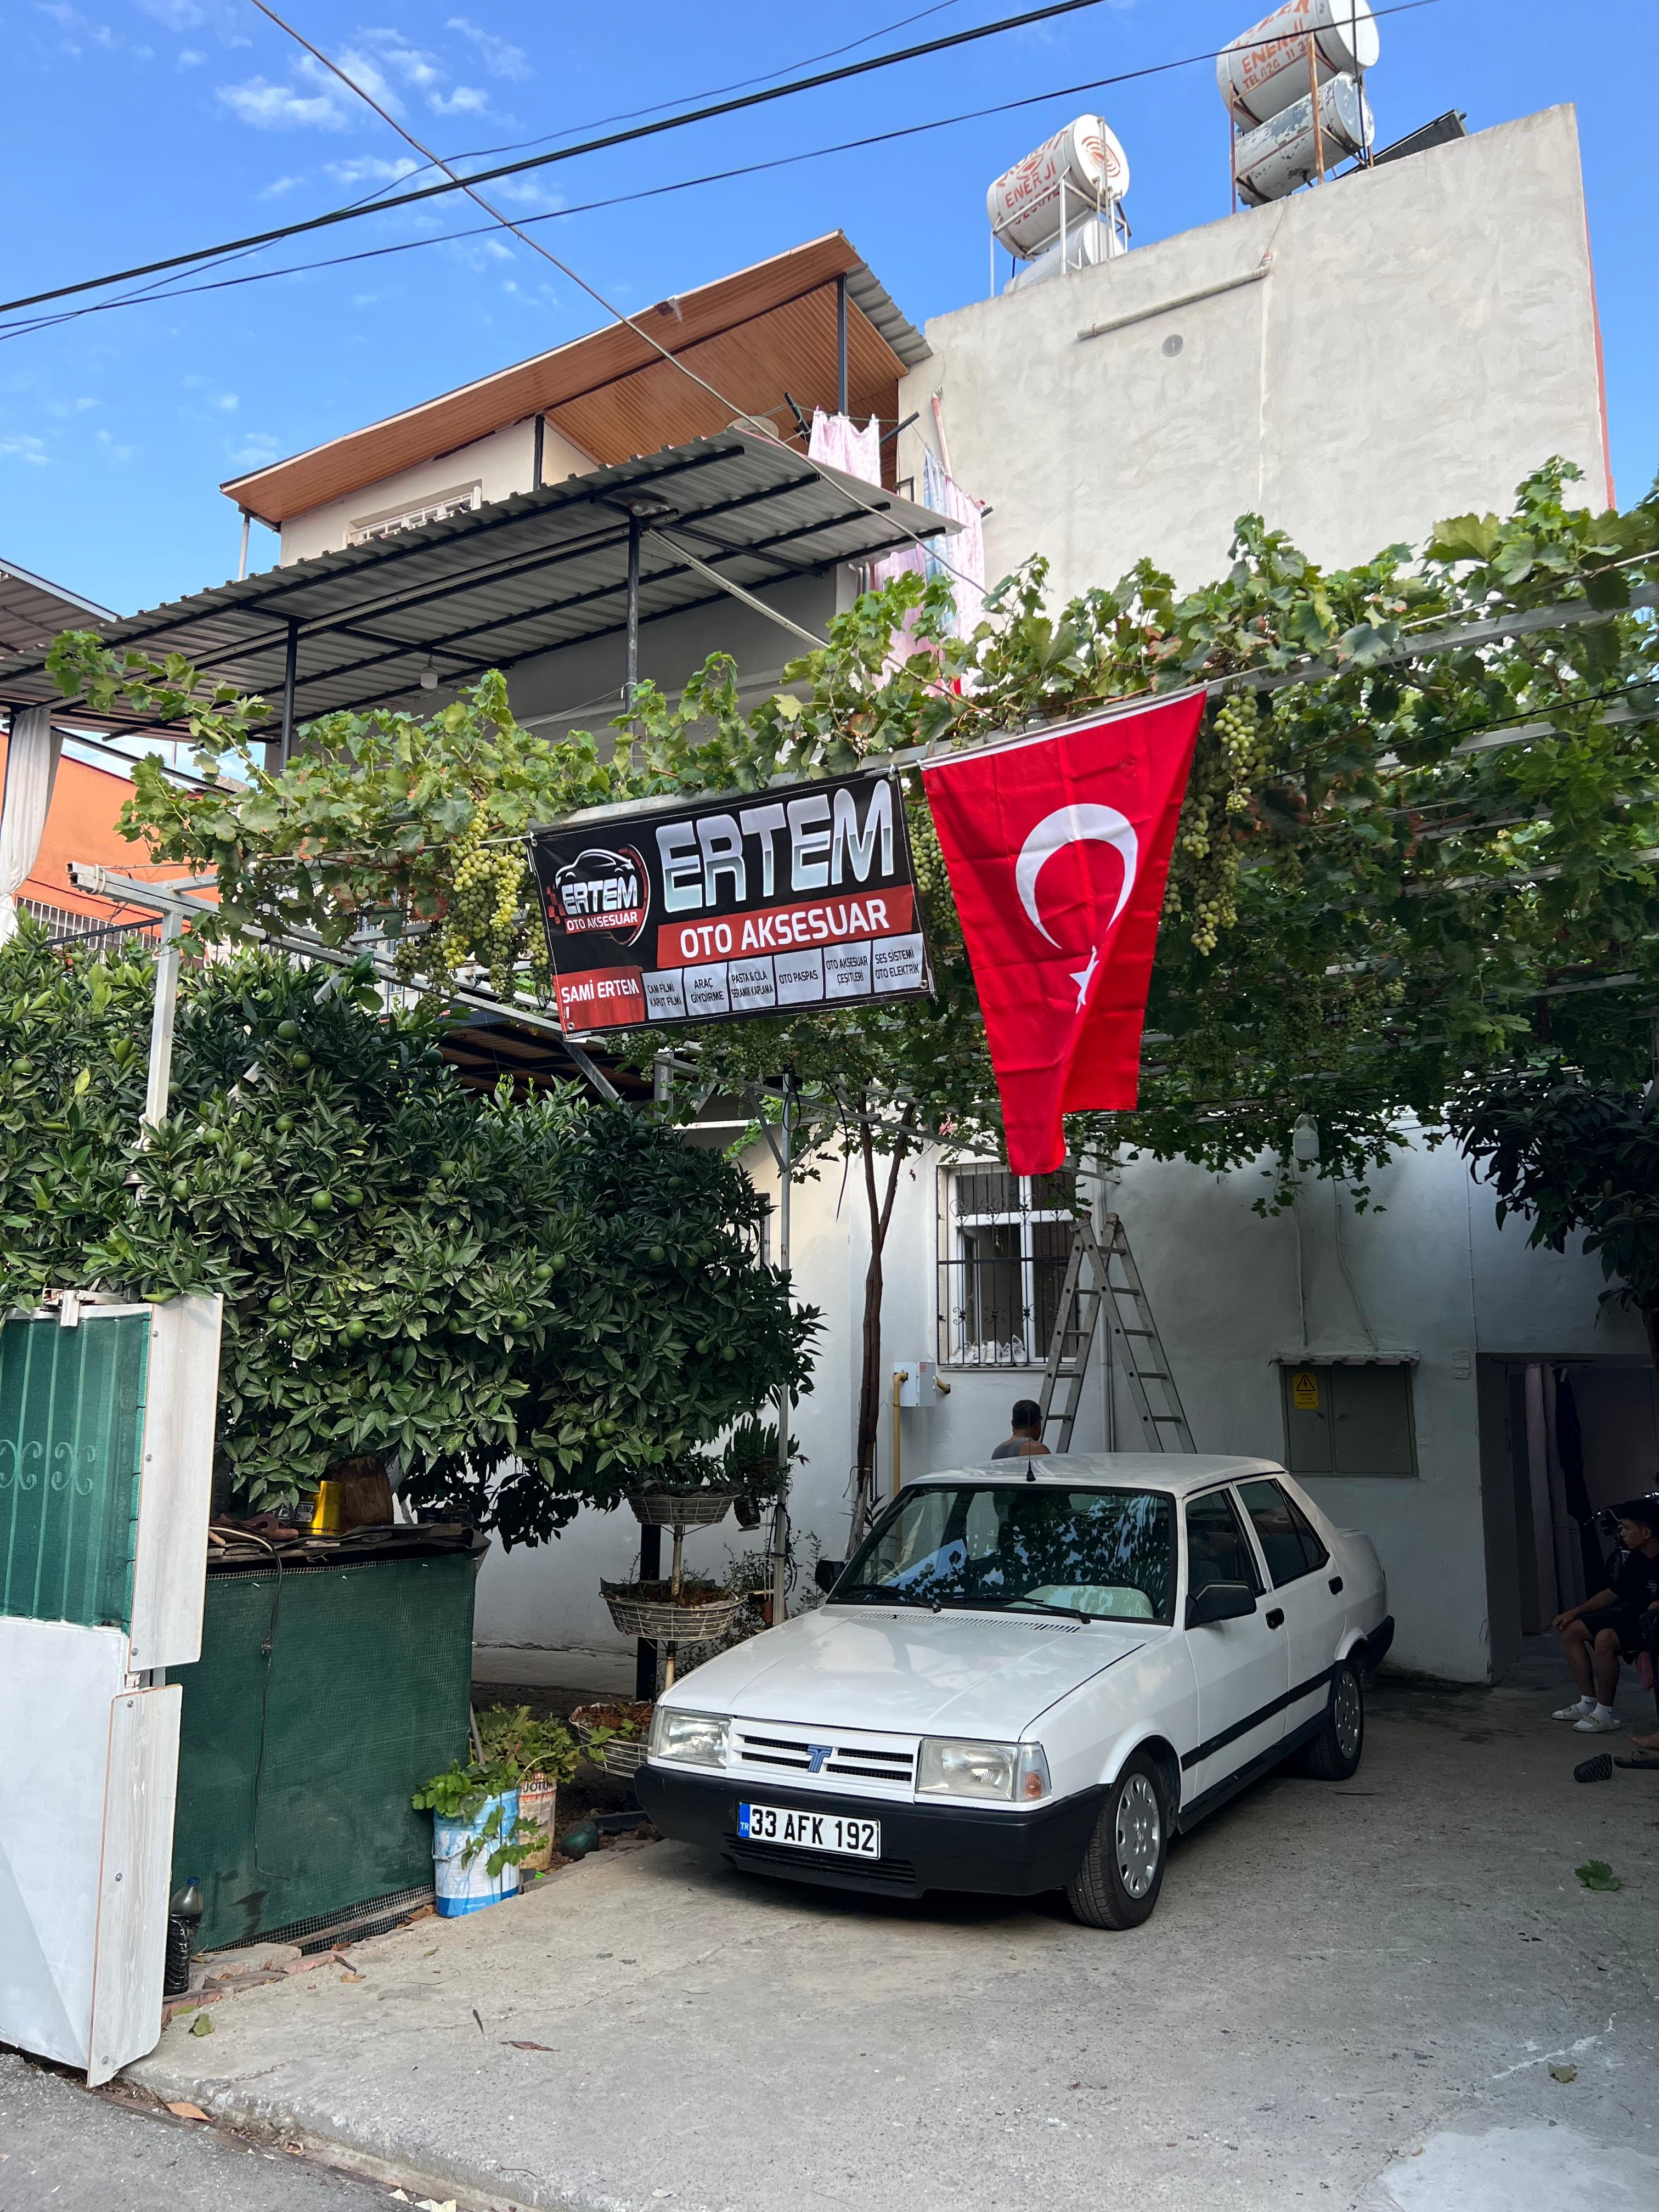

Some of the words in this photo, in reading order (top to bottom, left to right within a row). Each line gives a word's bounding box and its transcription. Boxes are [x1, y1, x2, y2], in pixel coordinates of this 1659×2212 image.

[656, 779, 894, 913] ERTEM
[561, 874, 637, 915] ERTEM
[566, 918, 585, 931] OTO
[588, 911, 638, 929] AKSESUAR
[680, 923, 732, 958] OTO
[741, 899, 889, 951] AKSESUAR
[826, 961, 838, 970] OTO
[839, 956, 868, 968] AKSESUAR
[875, 953, 888, 964] SES
[888, 946, 915, 962] SİSTEMİ
[731, 973, 749, 984] PASTA
[749, 972, 755, 981] &
[754, 969, 768, 981] CİLA
[779, 973, 793, 984] OTO
[793, 970, 819, 982] PASPAS
[837, 969, 865, 986] ÇEŞİTLERİ
[874, 969, 888, 979] OTO
[890, 961, 919, 977] ELEKTRİK
[561, 979, 595, 1003] SAMİ
[597, 978, 640, 998] ERTEM
[647, 984, 659, 994] CAM
[659, 981, 675, 993] FİLMİ
[694, 978, 714, 990] ARAÇ
[751, 984, 774, 996] KAPLAMA
[649, 997, 666, 1007] KAPUT
[667, 994, 682, 1006] FİLMİ
[691, 990, 724, 1003] GİYDİRME
[740, 1822, 749, 1831] TR
[752, 1808, 777, 1837] 33
[784, 1814, 823, 1845] AFK
[836, 1820, 874, 1852] 192
